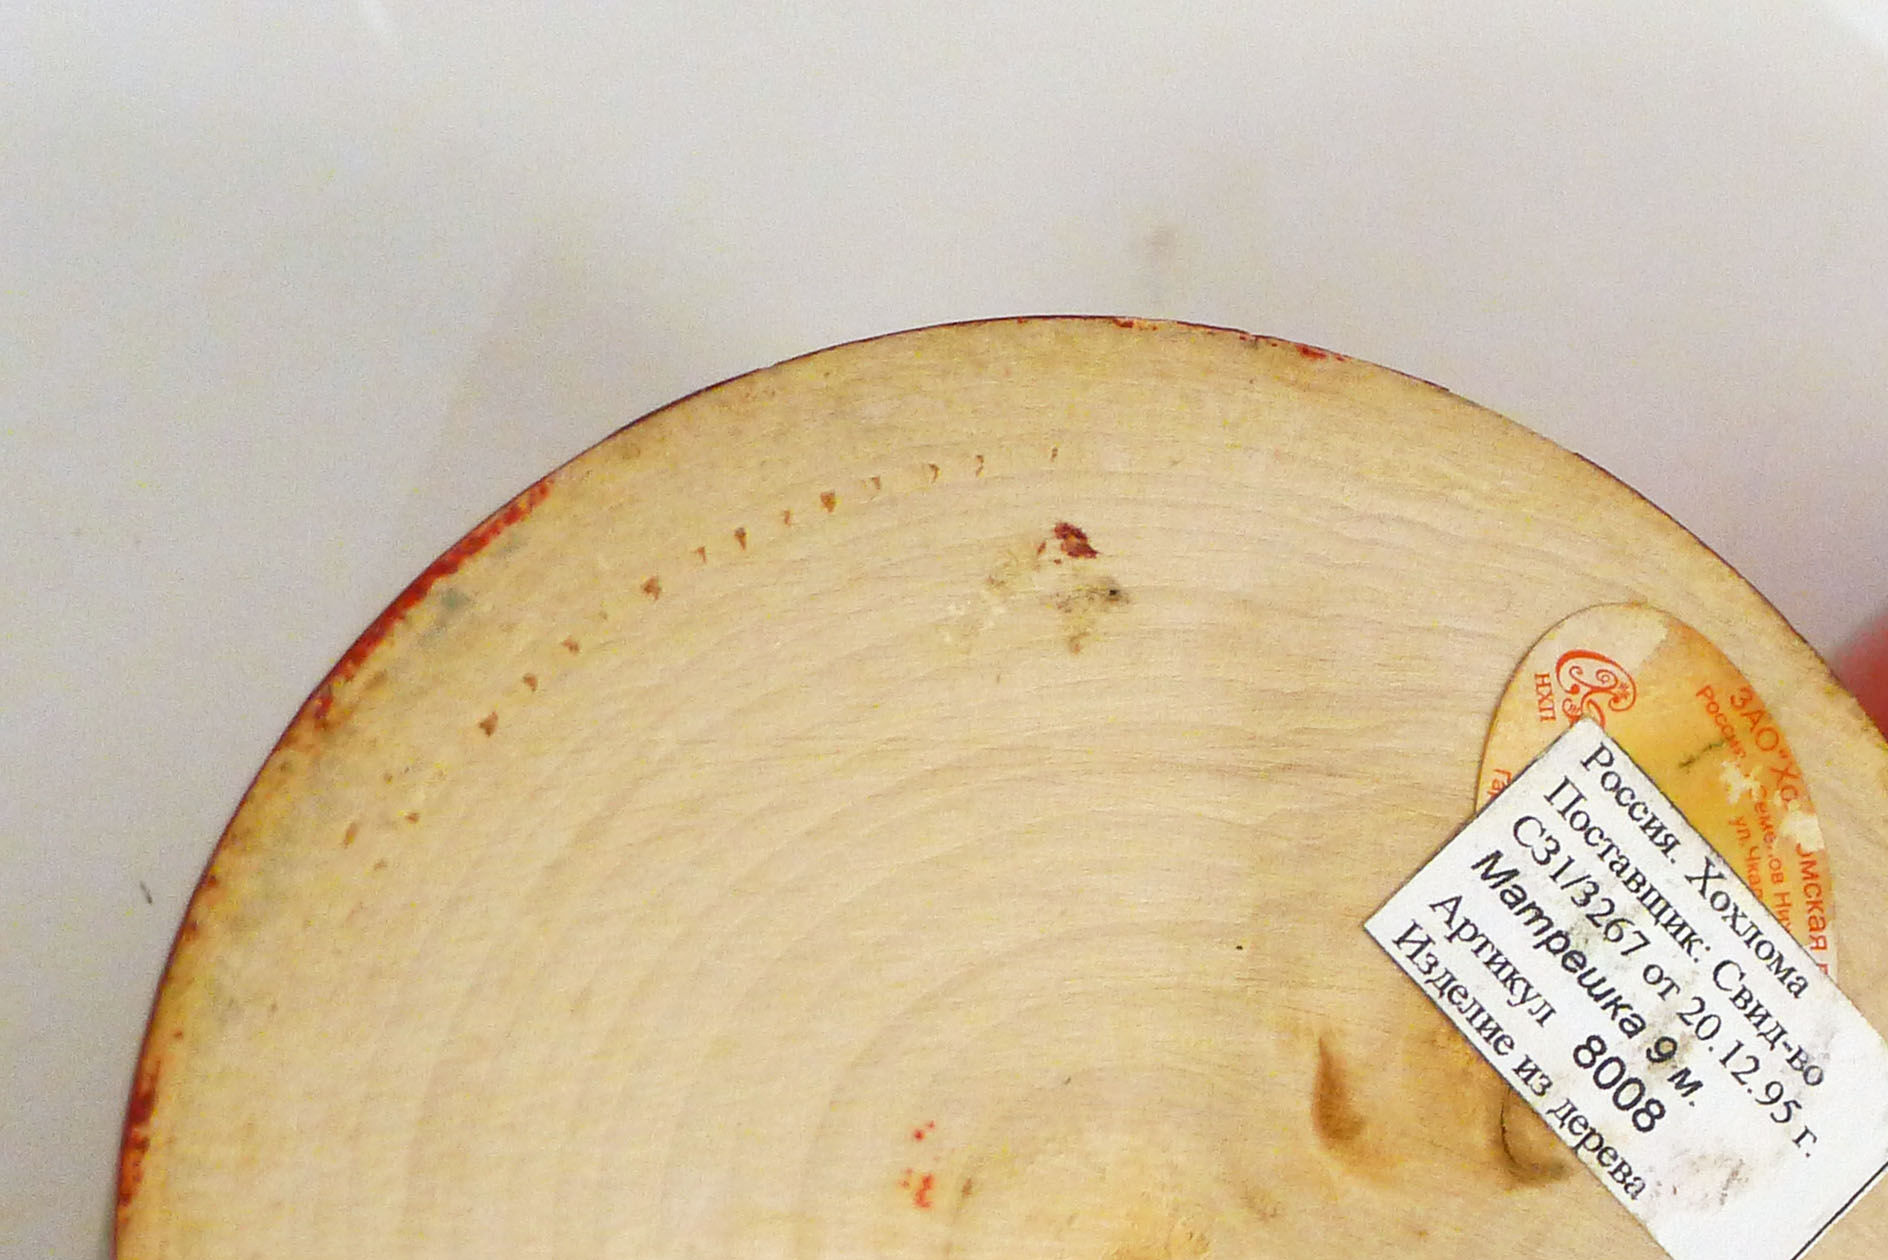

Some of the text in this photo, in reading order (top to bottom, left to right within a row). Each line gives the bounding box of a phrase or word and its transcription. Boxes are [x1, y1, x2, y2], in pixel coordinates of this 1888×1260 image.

[1535, 673, 1556, 722] НХП
[1471, 850, 1703, 1107] Матрешка 9 м.
[1543, 775, 1711, 963] Поставщик:
[1712, 959, 1824, 1086] Свид-во
[1580, 741, 1681, 864] Россия.
[1684, 856, 1809, 999] Хохлома
[1392, 919, 1646, 1200] Изделие из дерева
[1429, 895, 1666, 1133] Артикул 8008
[1643, 964, 1681, 1001] от
[1677, 996, 1802, 1123] 20.12.95
[1792, 1125, 1818, 1158] г.
